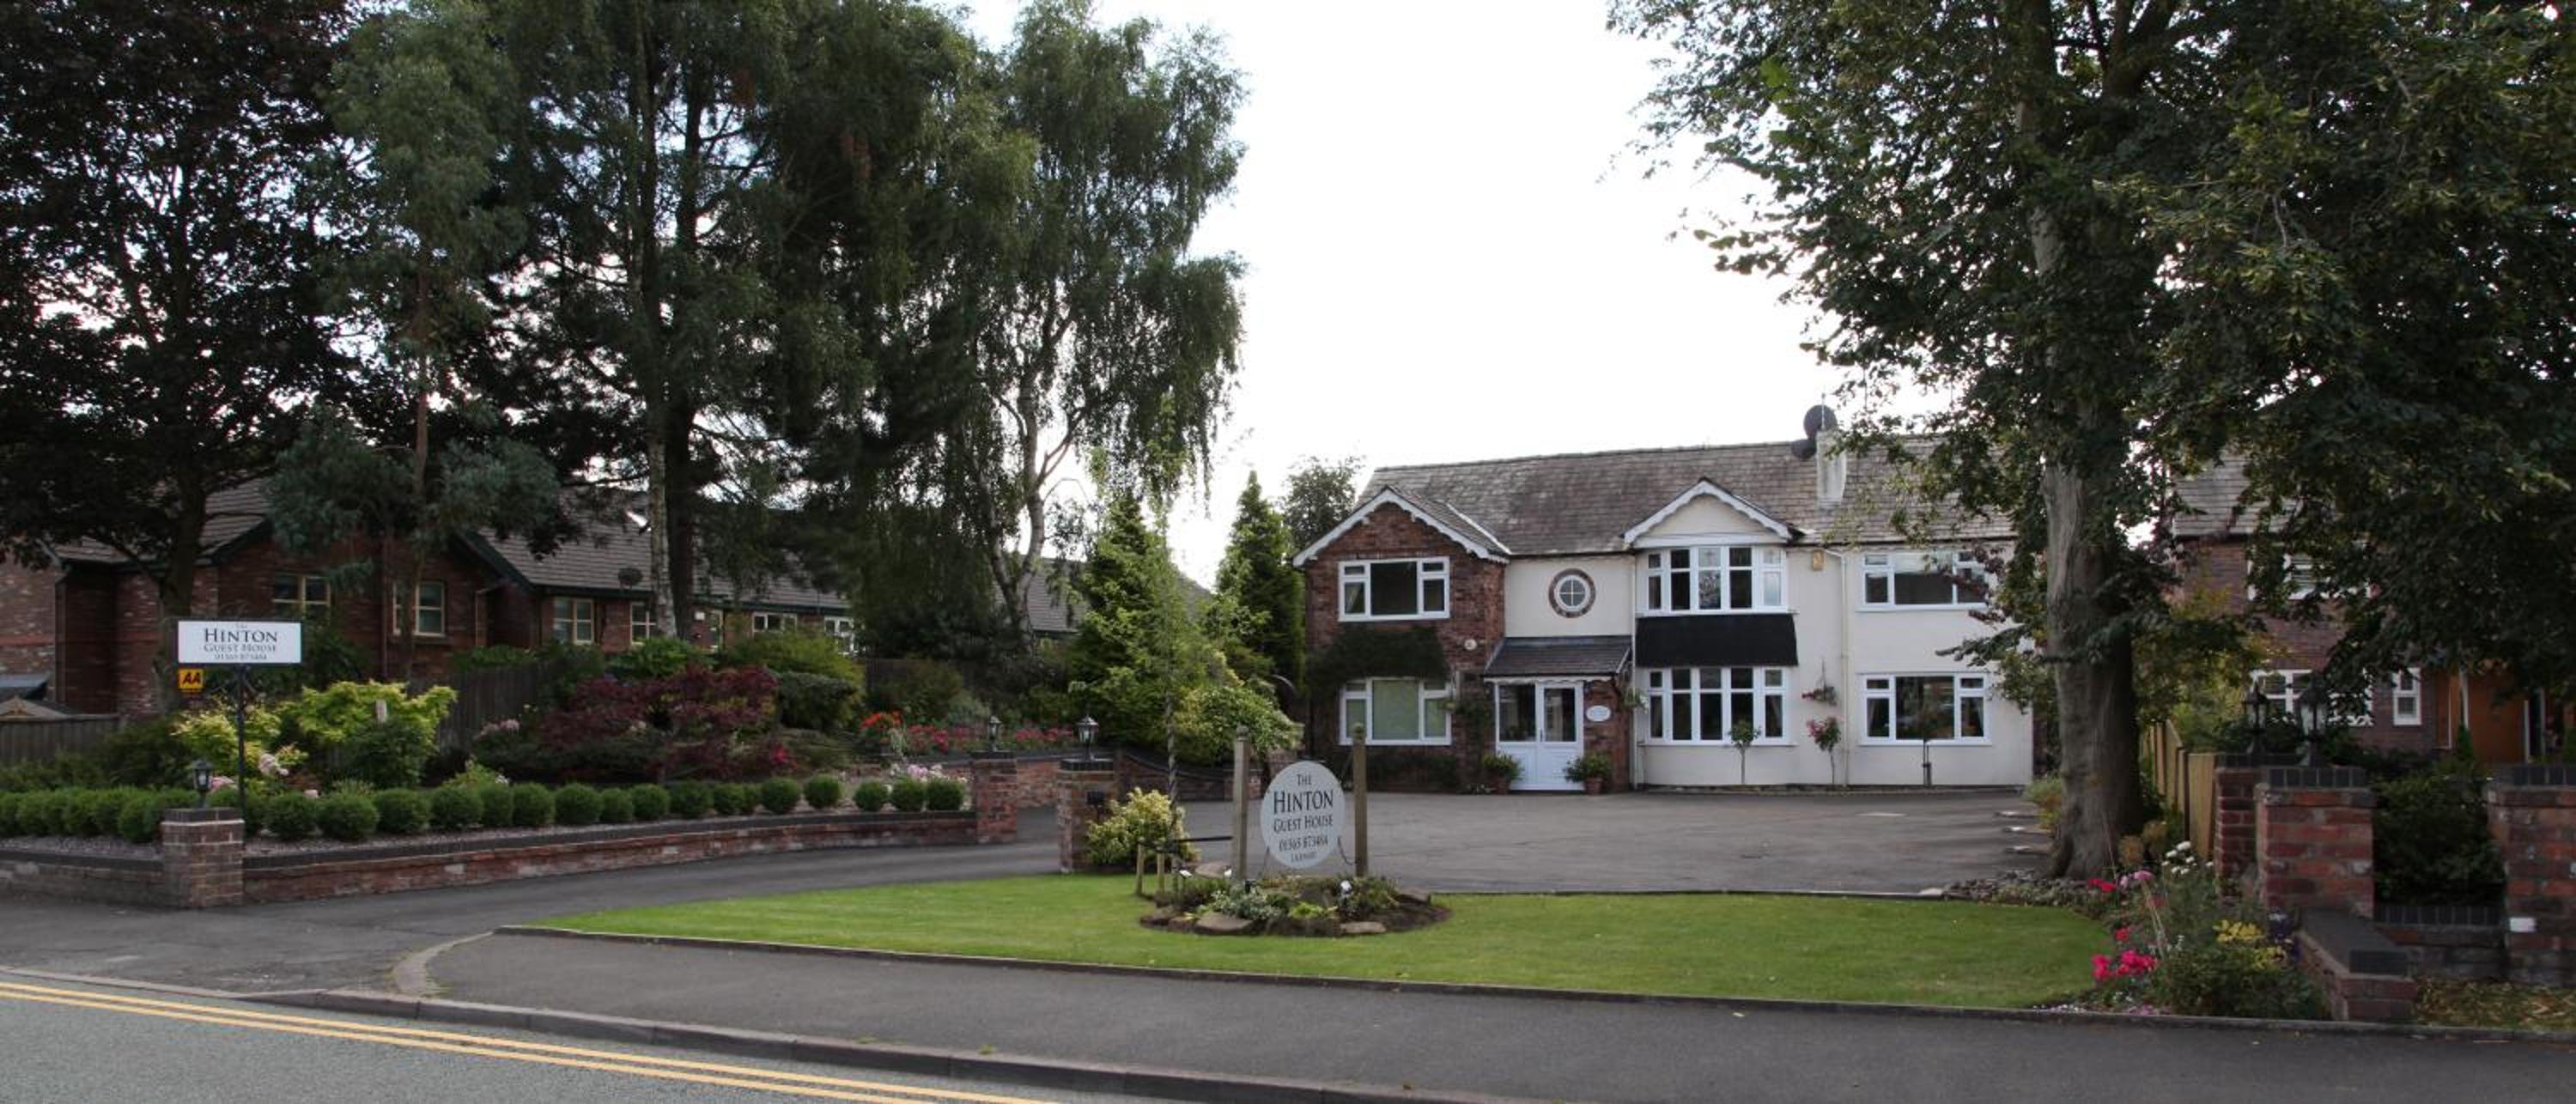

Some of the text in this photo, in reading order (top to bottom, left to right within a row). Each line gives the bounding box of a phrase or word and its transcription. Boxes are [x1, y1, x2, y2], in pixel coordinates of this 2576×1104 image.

[204, 628, 278, 643] HINTON
[204, 644, 276, 652] GUEST HOUSE
[182, 672, 201, 684] AA
[1296, 773, 1312, 786] THE
[1273, 789, 1334, 814] HINTON
[1273, 814, 1334, 834] GUEST HOUSE
